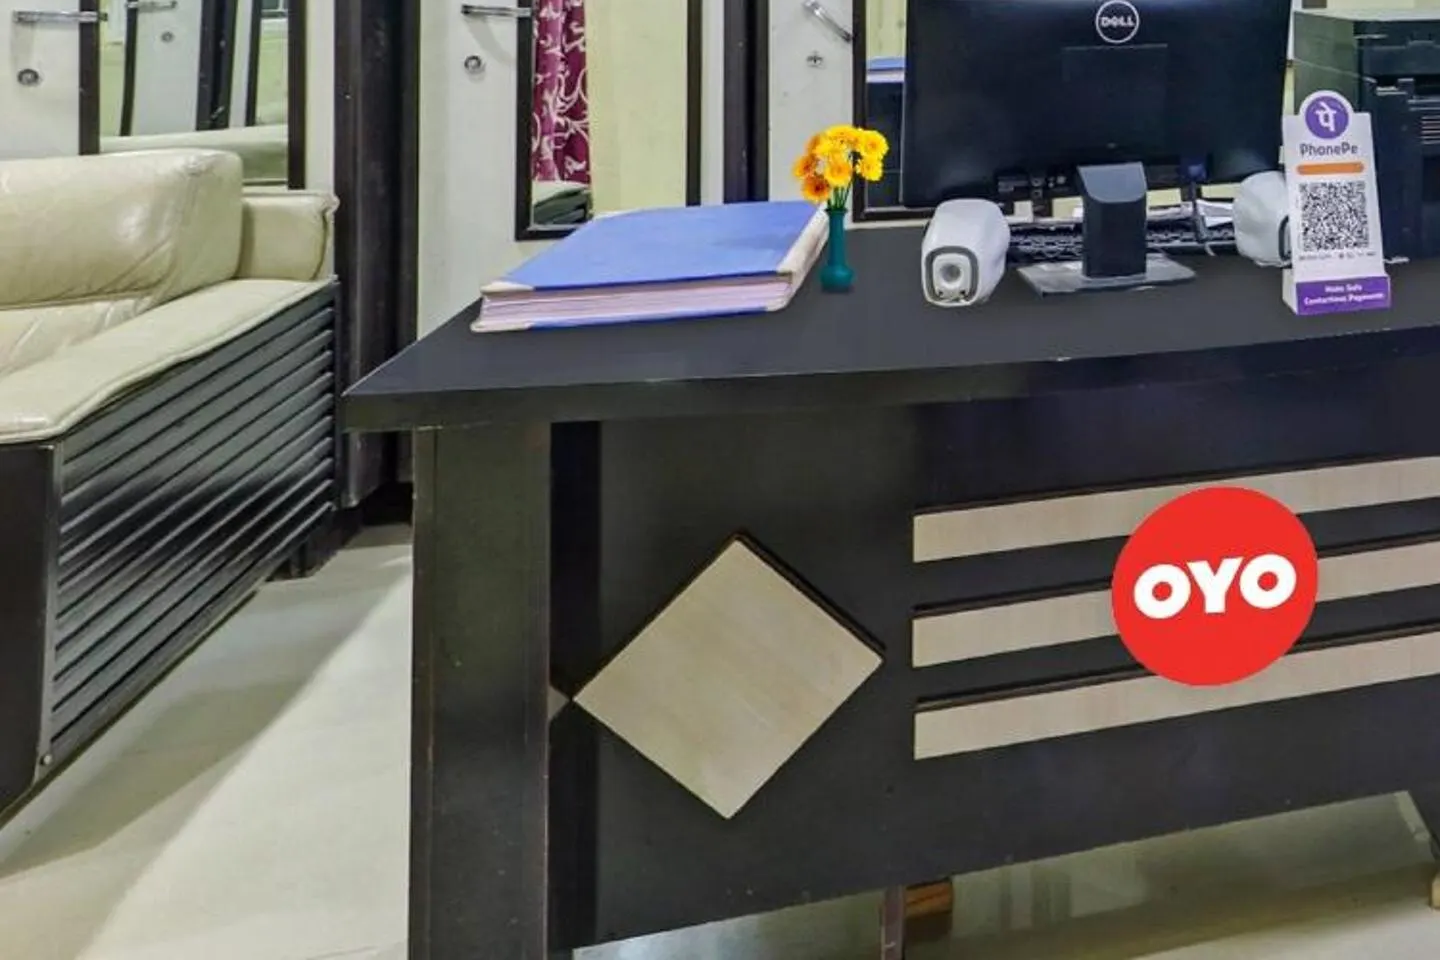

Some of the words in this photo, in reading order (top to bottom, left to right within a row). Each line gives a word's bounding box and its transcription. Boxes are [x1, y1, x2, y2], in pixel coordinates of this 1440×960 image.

[1100, 15, 1135, 28] DELL
[1299, 142, 1359, 158] PhonePe
[1133, 553, 1297, 620] OYO
